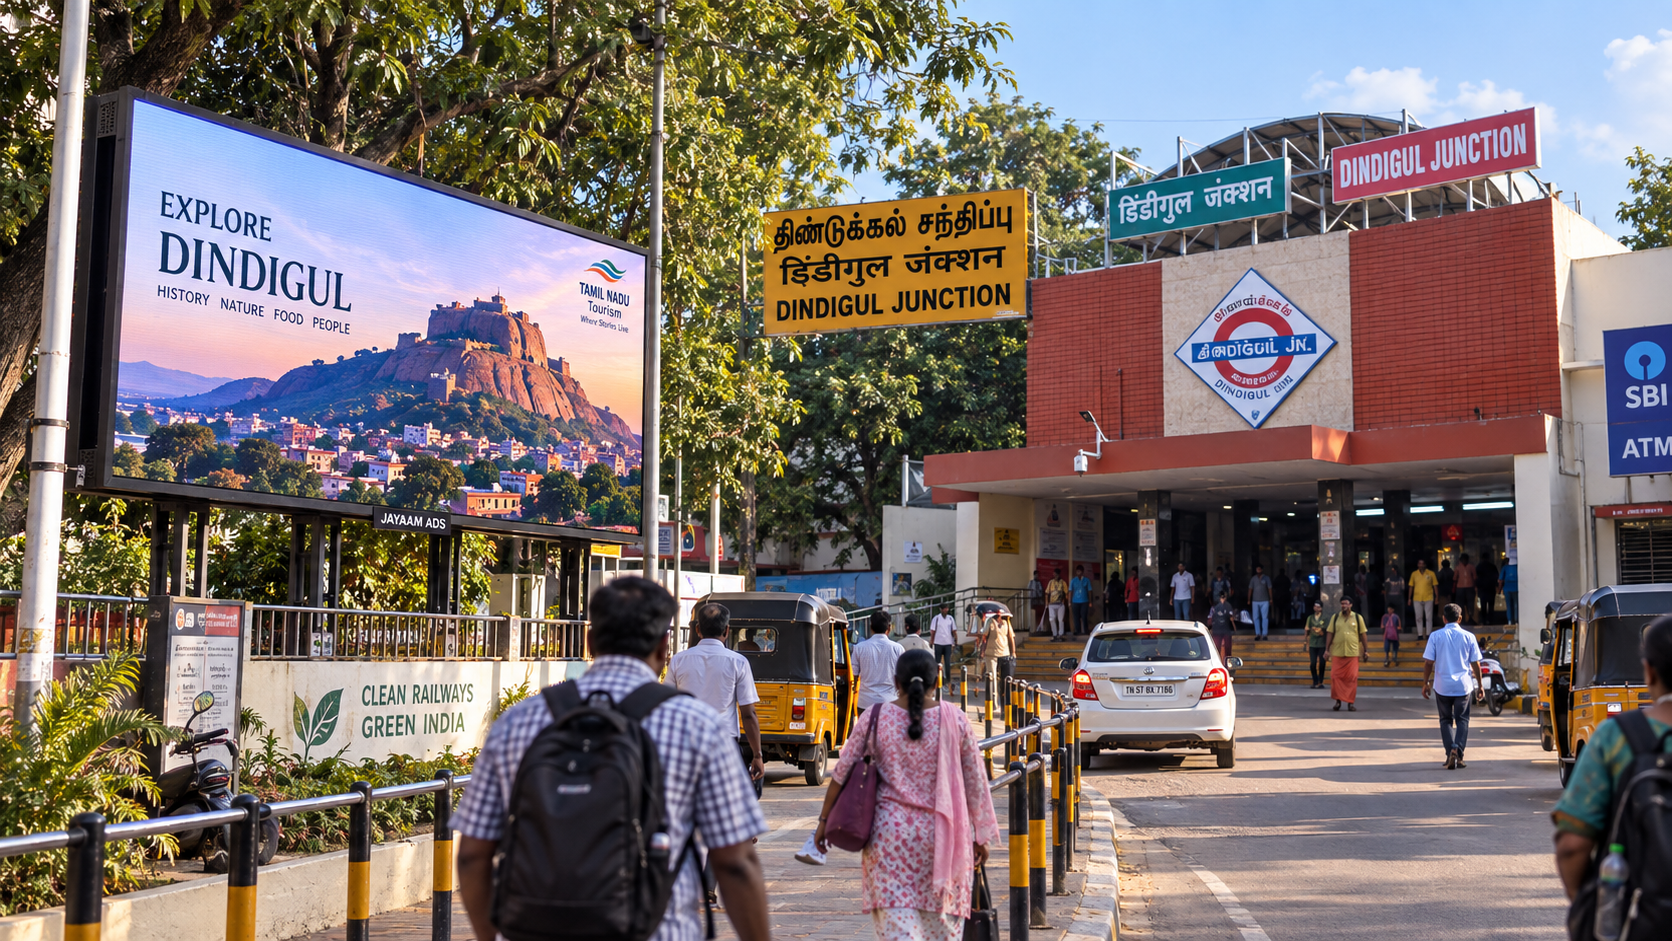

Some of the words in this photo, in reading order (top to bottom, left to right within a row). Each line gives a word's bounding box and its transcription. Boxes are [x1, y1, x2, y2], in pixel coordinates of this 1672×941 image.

[1340, 145, 1425, 188] DINDIGUL
[1430, 123, 1526, 171] JUNCTION
[1118, 190, 1194, 224] डिंडीगुल
[1203, 178, 1273, 207] जंक्शन
[160, 191, 272, 242] EXPLORE
[772, 208, 906, 254] திண்டுக்கல்
[917, 199, 1012, 241] சந்திப்பு
[158, 230, 352, 312] DINDIGUL
[903, 245, 1006, 275] जंक्शन
[579, 282, 605, 300] TAMIL
[606, 289, 630, 307] NADU
[588, 300, 622, 319] Tourism
[777, 293, 884, 322] DINDIGUL
[891, 283, 1011, 313] JUNCTION
[157, 285, 210, 306] HISTORY
[220, 297, 265, 318] NATURE
[274, 308, 304, 325] FOOD
[312, 316, 351, 335] PEOPLE
[1625, 383, 1668, 409] SBI
[1622, 436, 1672, 459] ATM
[381, 512, 423, 528] JAYAAM
[425, 516, 446, 530] ADS
[362, 684, 407, 707] CLEAN
[412, 683, 474, 705] RAILWAYS
[362, 714, 416, 739] GREEN
[424, 712, 465, 735] INDIA
